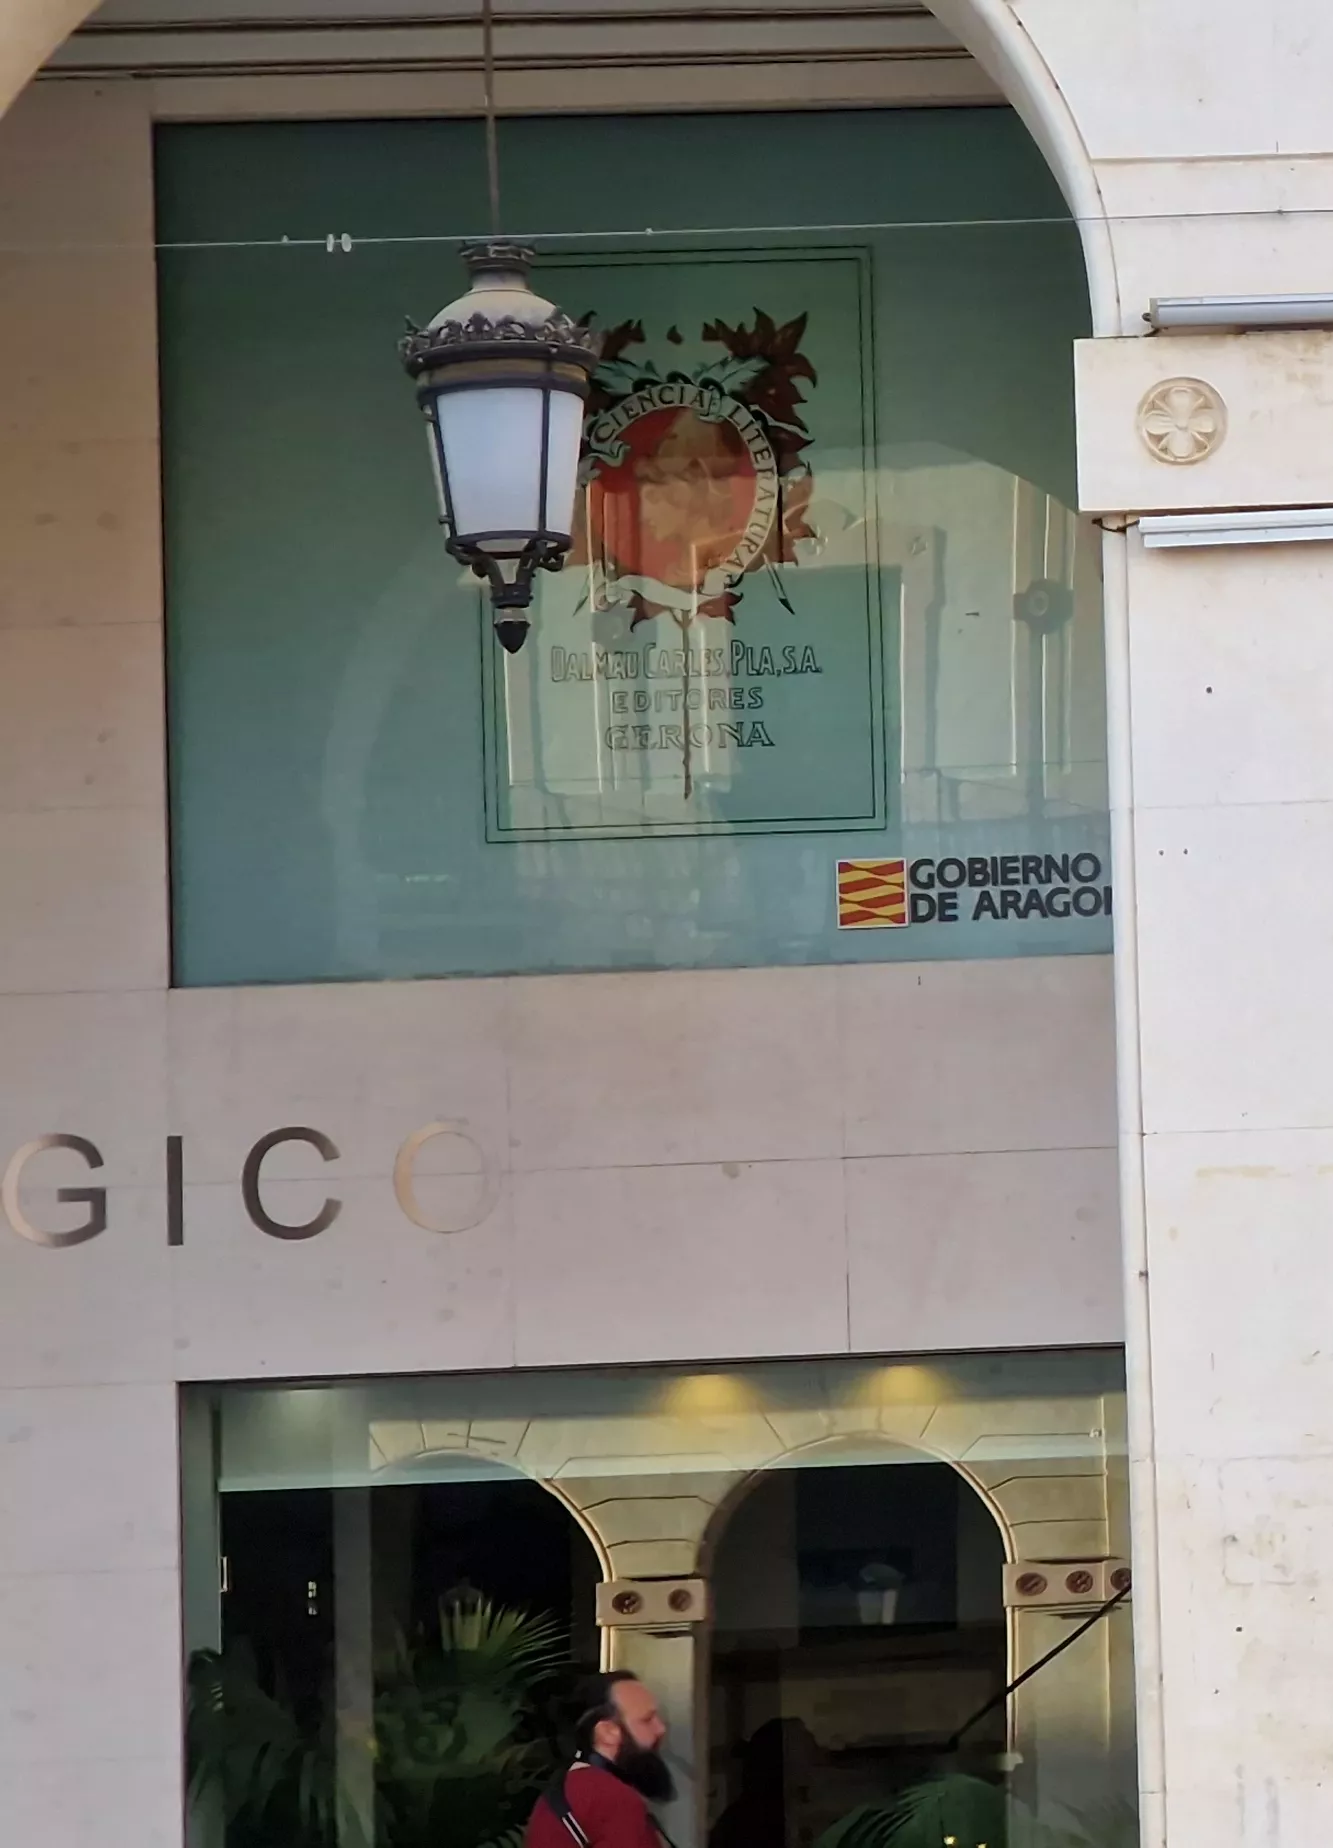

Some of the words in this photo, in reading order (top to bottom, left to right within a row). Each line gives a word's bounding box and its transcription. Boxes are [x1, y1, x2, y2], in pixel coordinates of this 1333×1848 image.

[612, 686, 764, 714] EDITORES
[605, 721, 776, 750] GERONA
[909, 852, 1102, 889] GOBIERNO
[910, 891, 959, 923] DE
